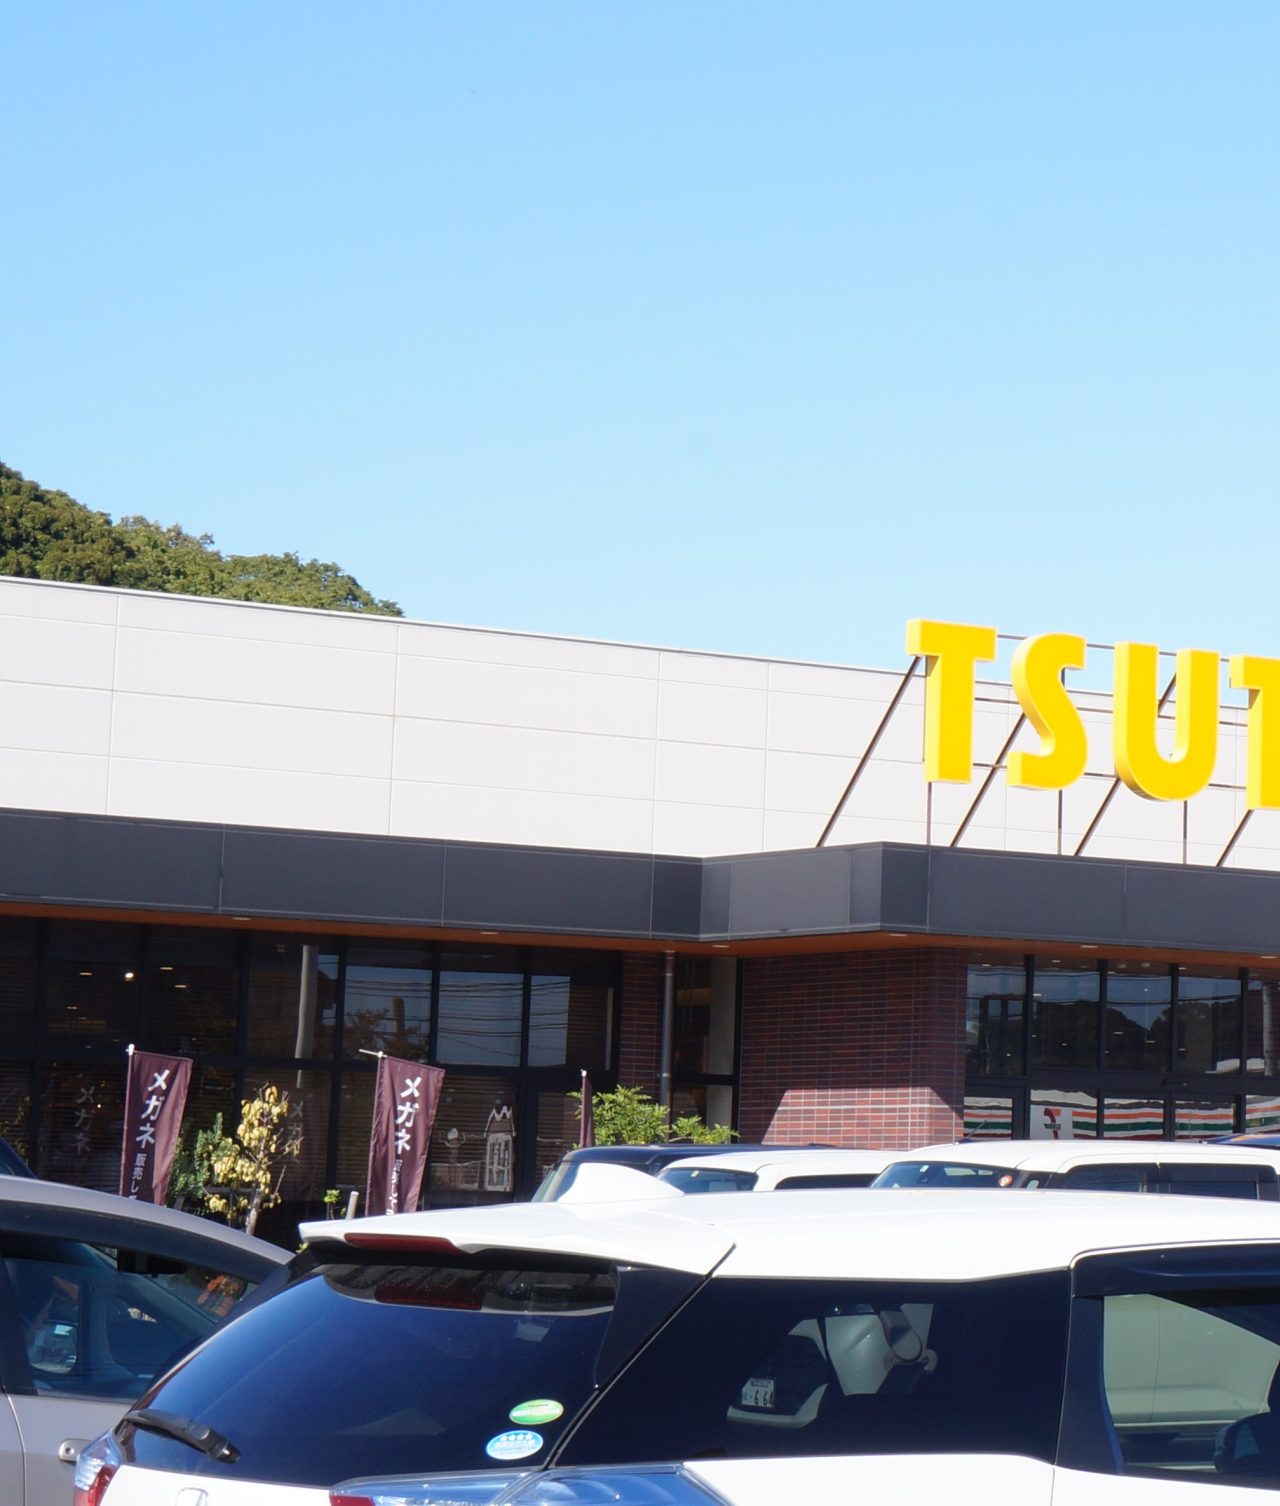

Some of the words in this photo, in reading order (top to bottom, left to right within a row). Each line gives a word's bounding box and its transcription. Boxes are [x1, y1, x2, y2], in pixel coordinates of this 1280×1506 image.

[135, 1068, 170, 1149] メガネ
[394, 1076, 423, 1155] メガネ
